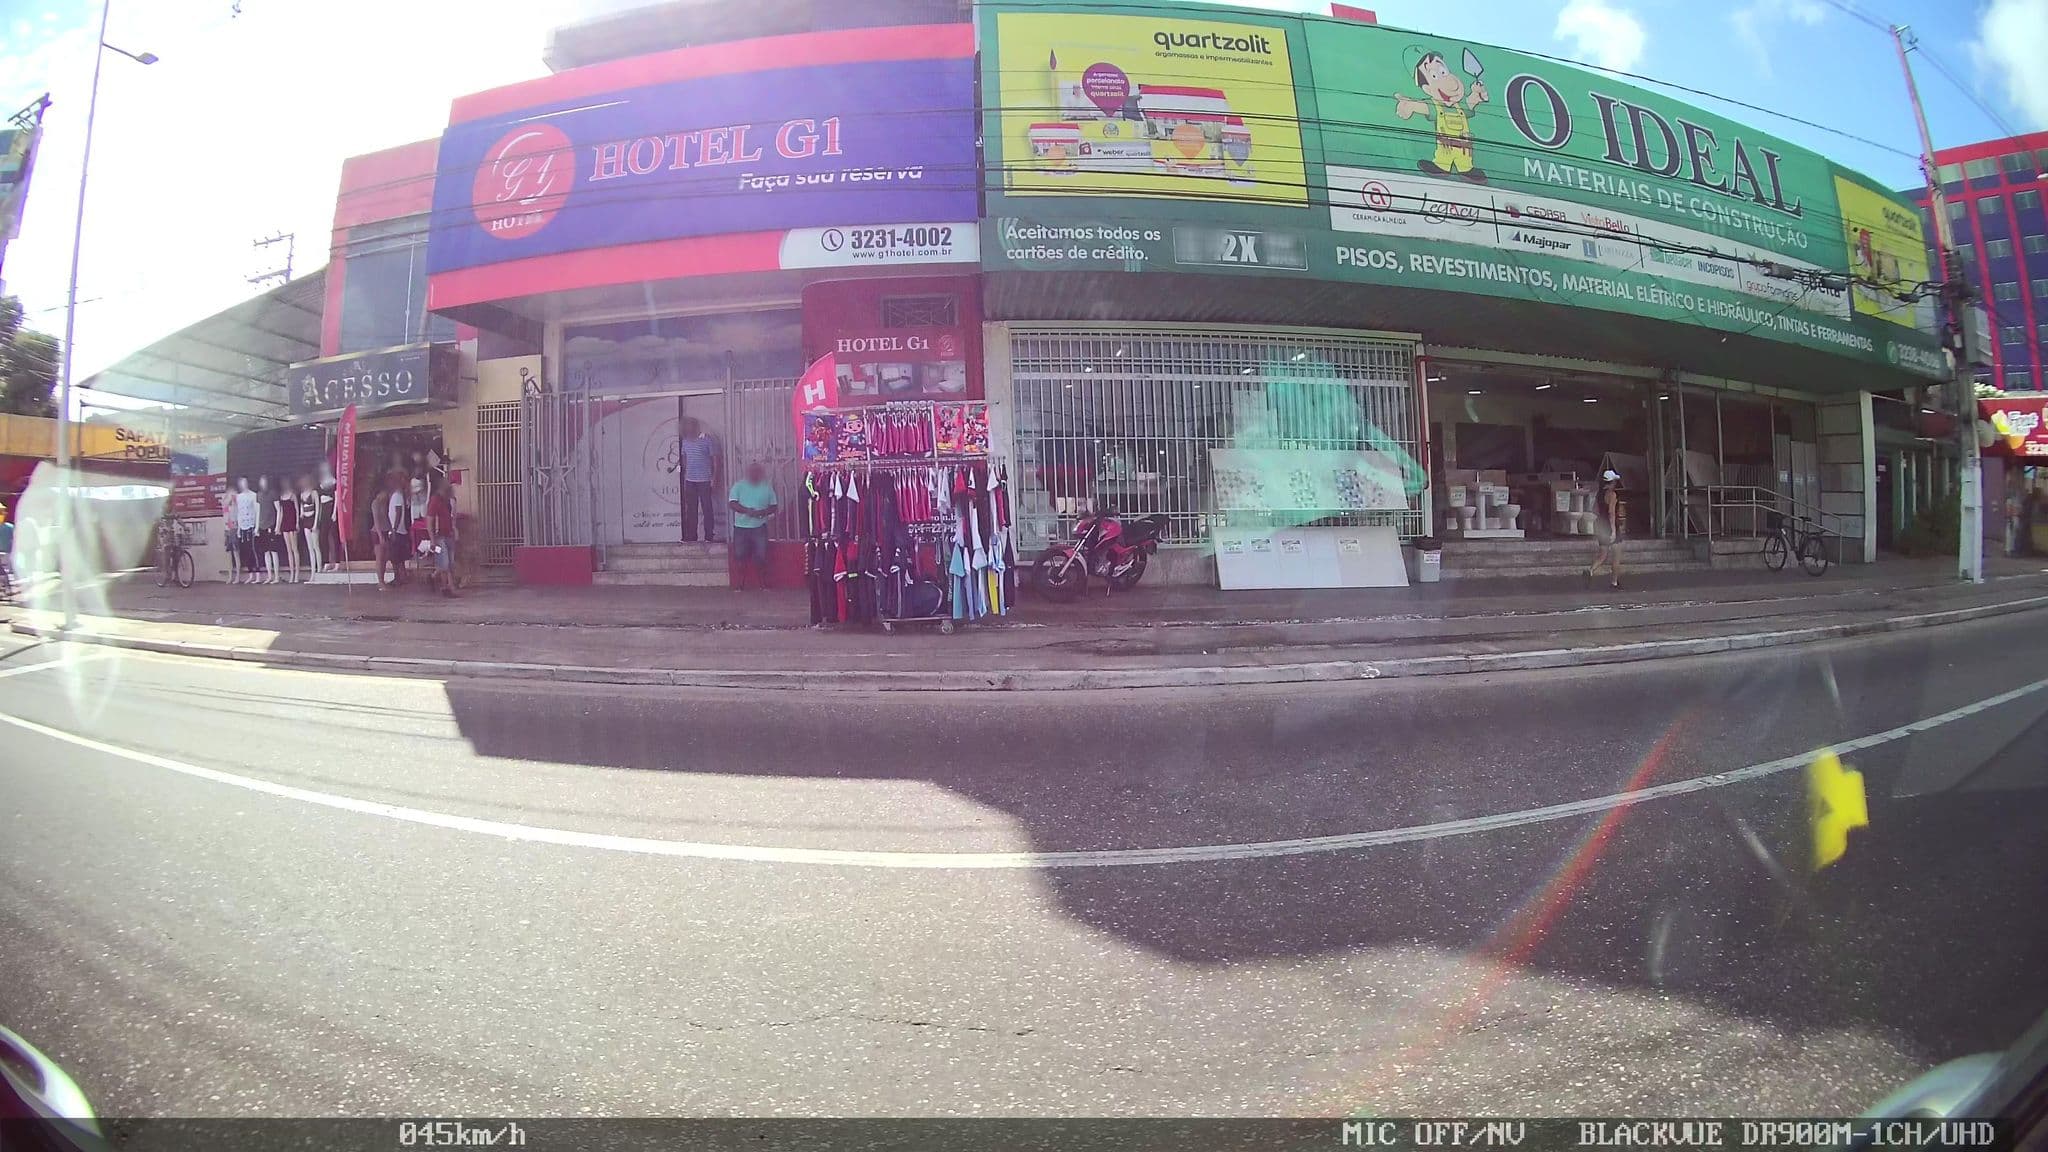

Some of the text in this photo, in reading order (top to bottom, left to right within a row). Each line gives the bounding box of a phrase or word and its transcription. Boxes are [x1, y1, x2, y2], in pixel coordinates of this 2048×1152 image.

[1154, 31, 1271, 55] quartzolit
[1155, 51, 1198, 60] argamassas
[589, 116, 843, 182] HOTEL G1
[1504, 72, 1804, 219] O IDEAL
[738, 165, 924, 192] Faça sua reserva
[1523, 157, 1808, 250] MATERIAIS DE CONSTRUÇÃO
[851, 227, 952, 249] 3231-4002
[1005, 224, 1161, 241] Aceitamos todos os
[1523, 234, 1572, 250] Majopar
[1007, 245, 1149, 260] cartões de crédito.
[1221, 234, 1259, 263] 2X
[1336, 246, 1873, 352] PISOS, REVESTIMENTOS, MATERIAL ELÉTRICO E HIDRÁULICO, TINTAS E FERRAMENTAS
[836, 336, 930, 353] HOTEL G1
[302, 370, 413, 406] ACESSO
